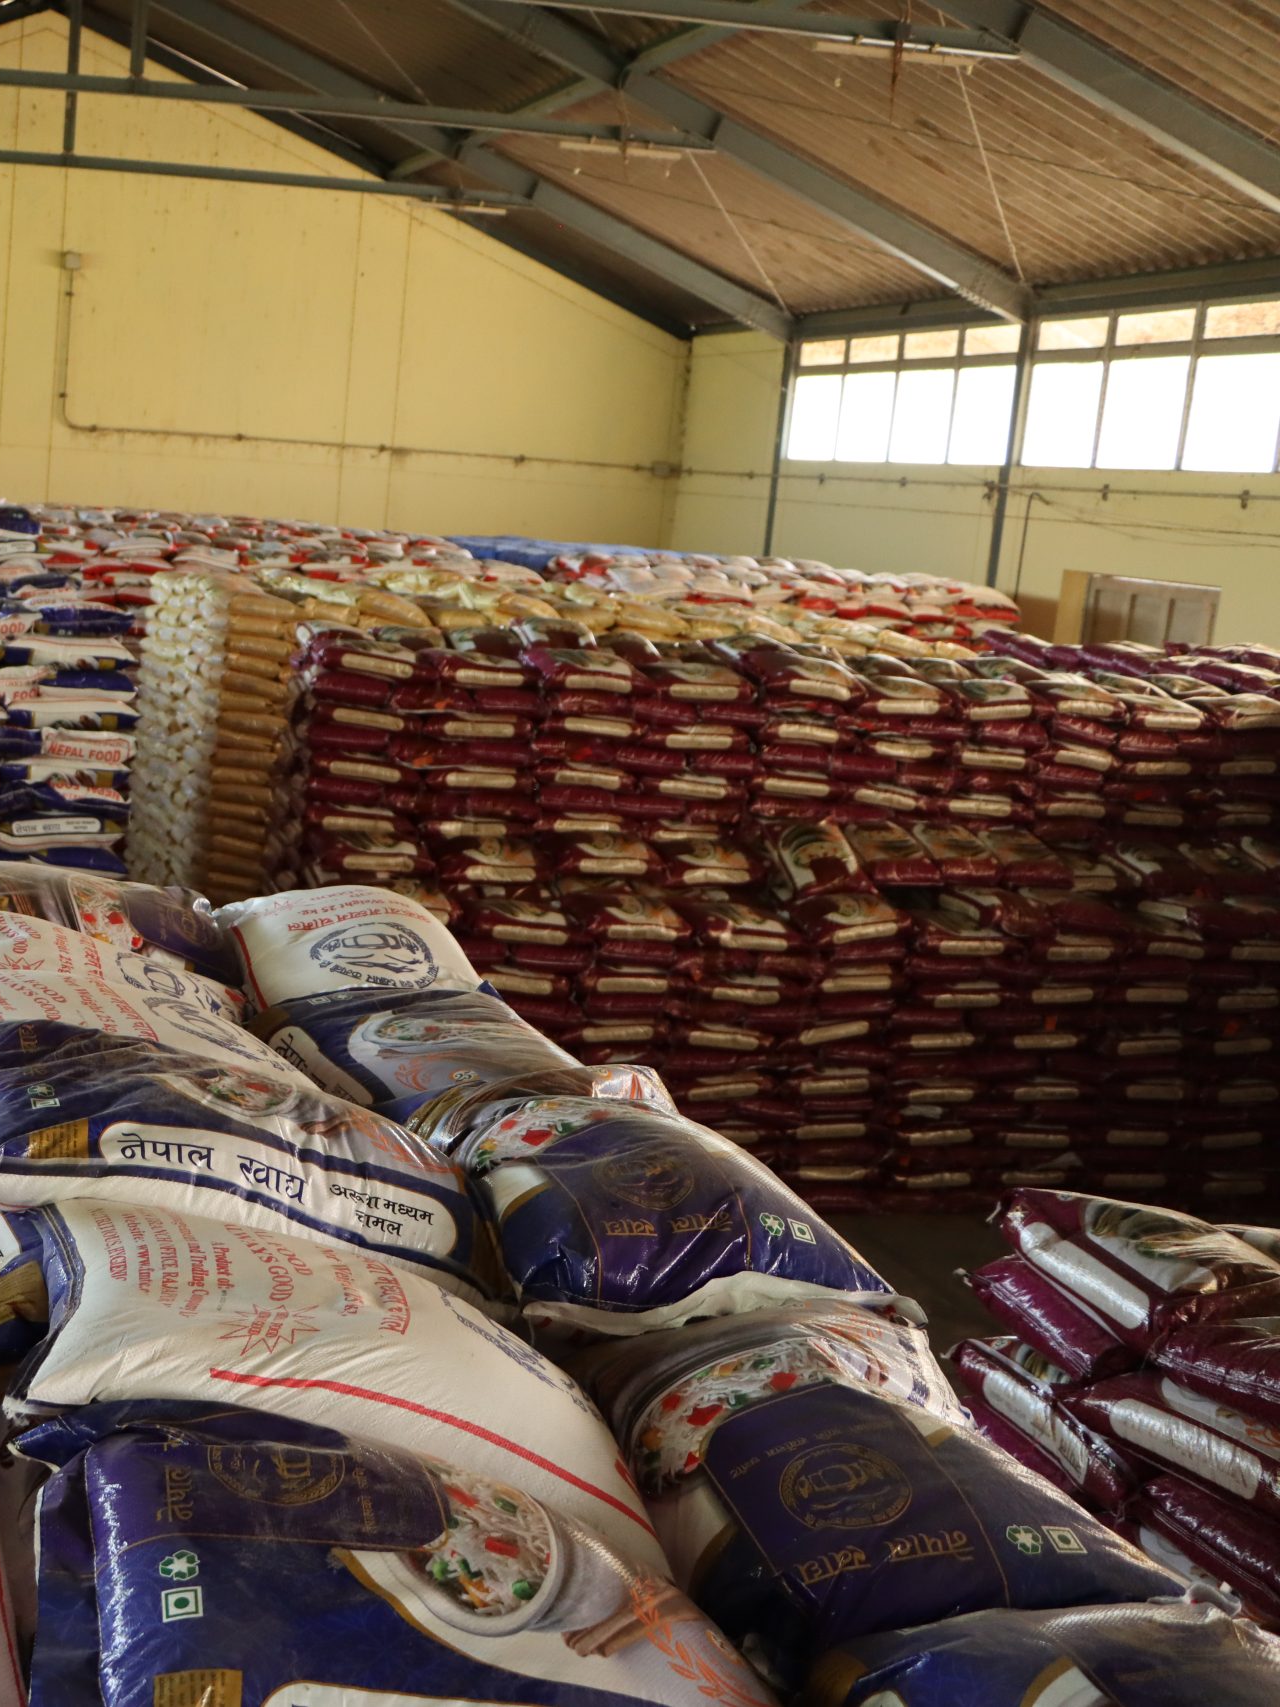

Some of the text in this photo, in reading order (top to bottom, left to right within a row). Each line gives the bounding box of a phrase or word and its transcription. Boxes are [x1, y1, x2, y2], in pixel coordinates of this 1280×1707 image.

[48, 743, 122, 762] NEPAL FOOD
[287, 906, 382, 933] मध्यम चामल
[297, 898, 385, 917] Weight 25 kg.
[454, 1070, 473, 1082] 25
[117, 1132, 307, 1204] नेपाल खाद्य
[355, 1209, 403, 1238] चामल
[383, 1197, 434, 1227] मध्यम
[601, 1218, 658, 1237] खाद्य
[188, 1255, 209, 1287] Trading
[214, 1247, 236, 1291] Product of:
[277, 1244, 313, 1277] FOOD
[268, 1263, 296, 1302] GOOD
[155, 1464, 194, 1523] नेपाल
[793, 1530, 975, 1586] नेपाल खाद्य
